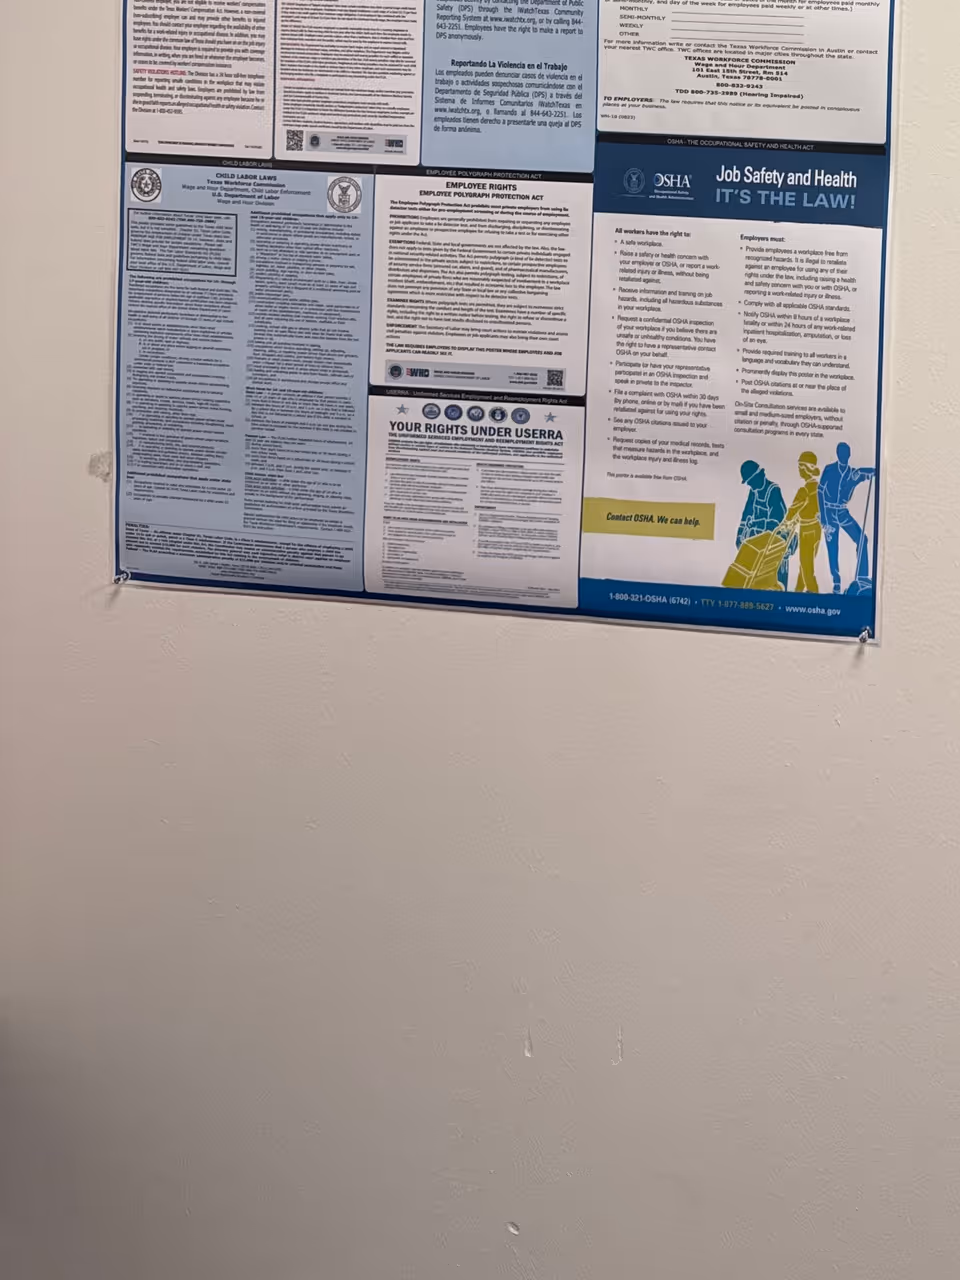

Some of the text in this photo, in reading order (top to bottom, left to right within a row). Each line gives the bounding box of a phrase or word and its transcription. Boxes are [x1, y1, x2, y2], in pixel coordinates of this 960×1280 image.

[450, 58, 487, 68] Reportando
[488, 60, 496, 68] La
[497, 60, 525, 69] Violencia
[543, 62, 567, 72] Trabajo
[653, 173, 690, 188] OSHA
[716, 164, 856, 187] Job Safety and Health
[445, 181, 517, 191] EMPLOYEE RIGHTS
[757, 190, 796, 206] THE
[802, 192, 855, 209] LAW!
[388, 420, 563, 442] YOUR RIGHTS UNDER USERRA
[607, 512, 632, 522] Contact
[634, 515, 655, 523] OSHA.
[657, 516, 668, 524] We
[683, 517, 700, 527] help.
[785, 606, 840, 616] www.osha.gov
